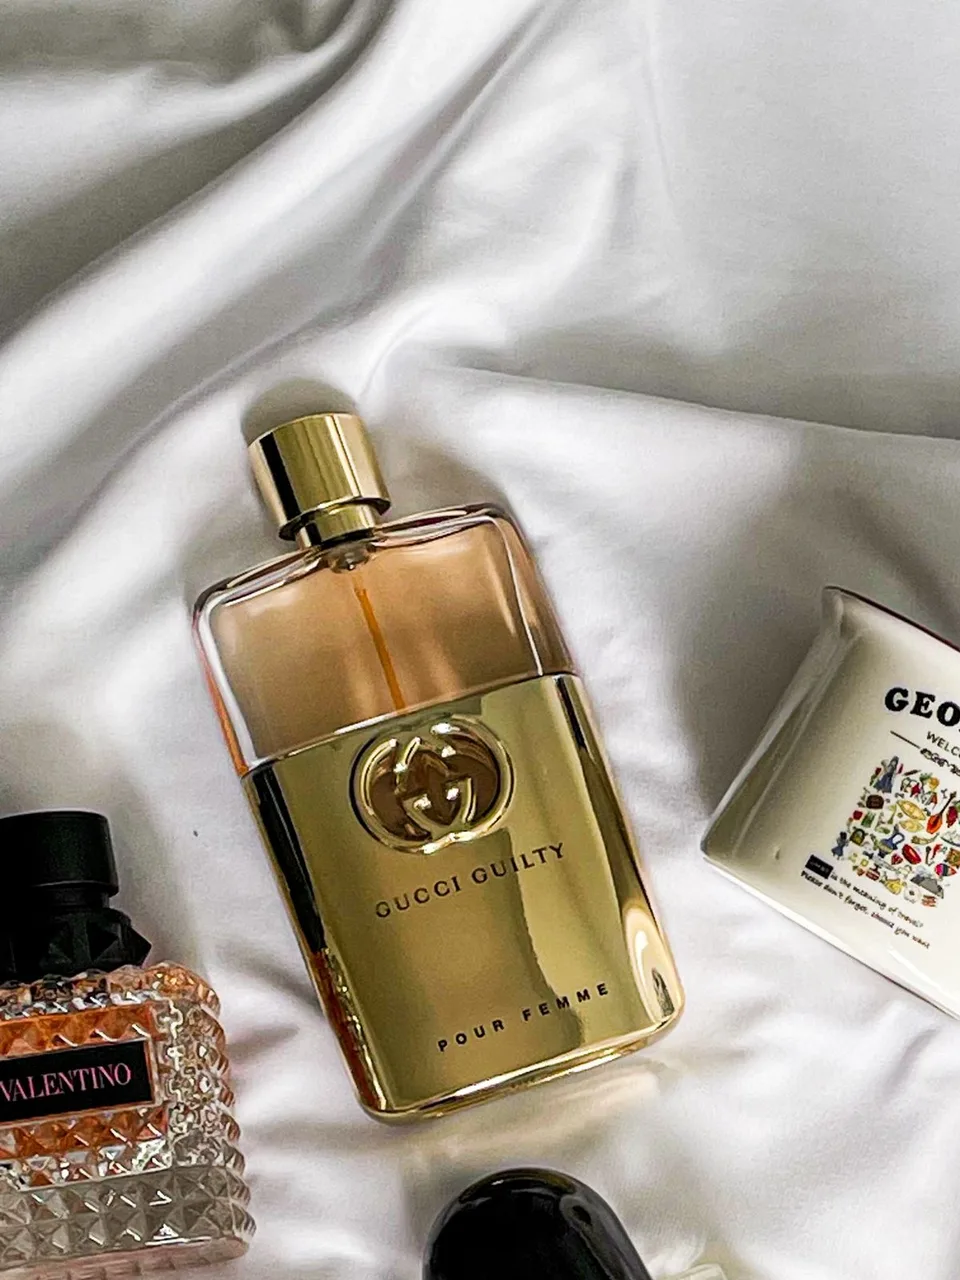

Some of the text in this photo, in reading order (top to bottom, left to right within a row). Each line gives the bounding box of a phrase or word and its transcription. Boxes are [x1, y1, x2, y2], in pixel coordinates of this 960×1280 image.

[375, 842, 565, 919] GUCCI GUILTY
[437, 983, 608, 1052] POUR FEMME
[0, 1062, 132, 1102] VALENTINO
